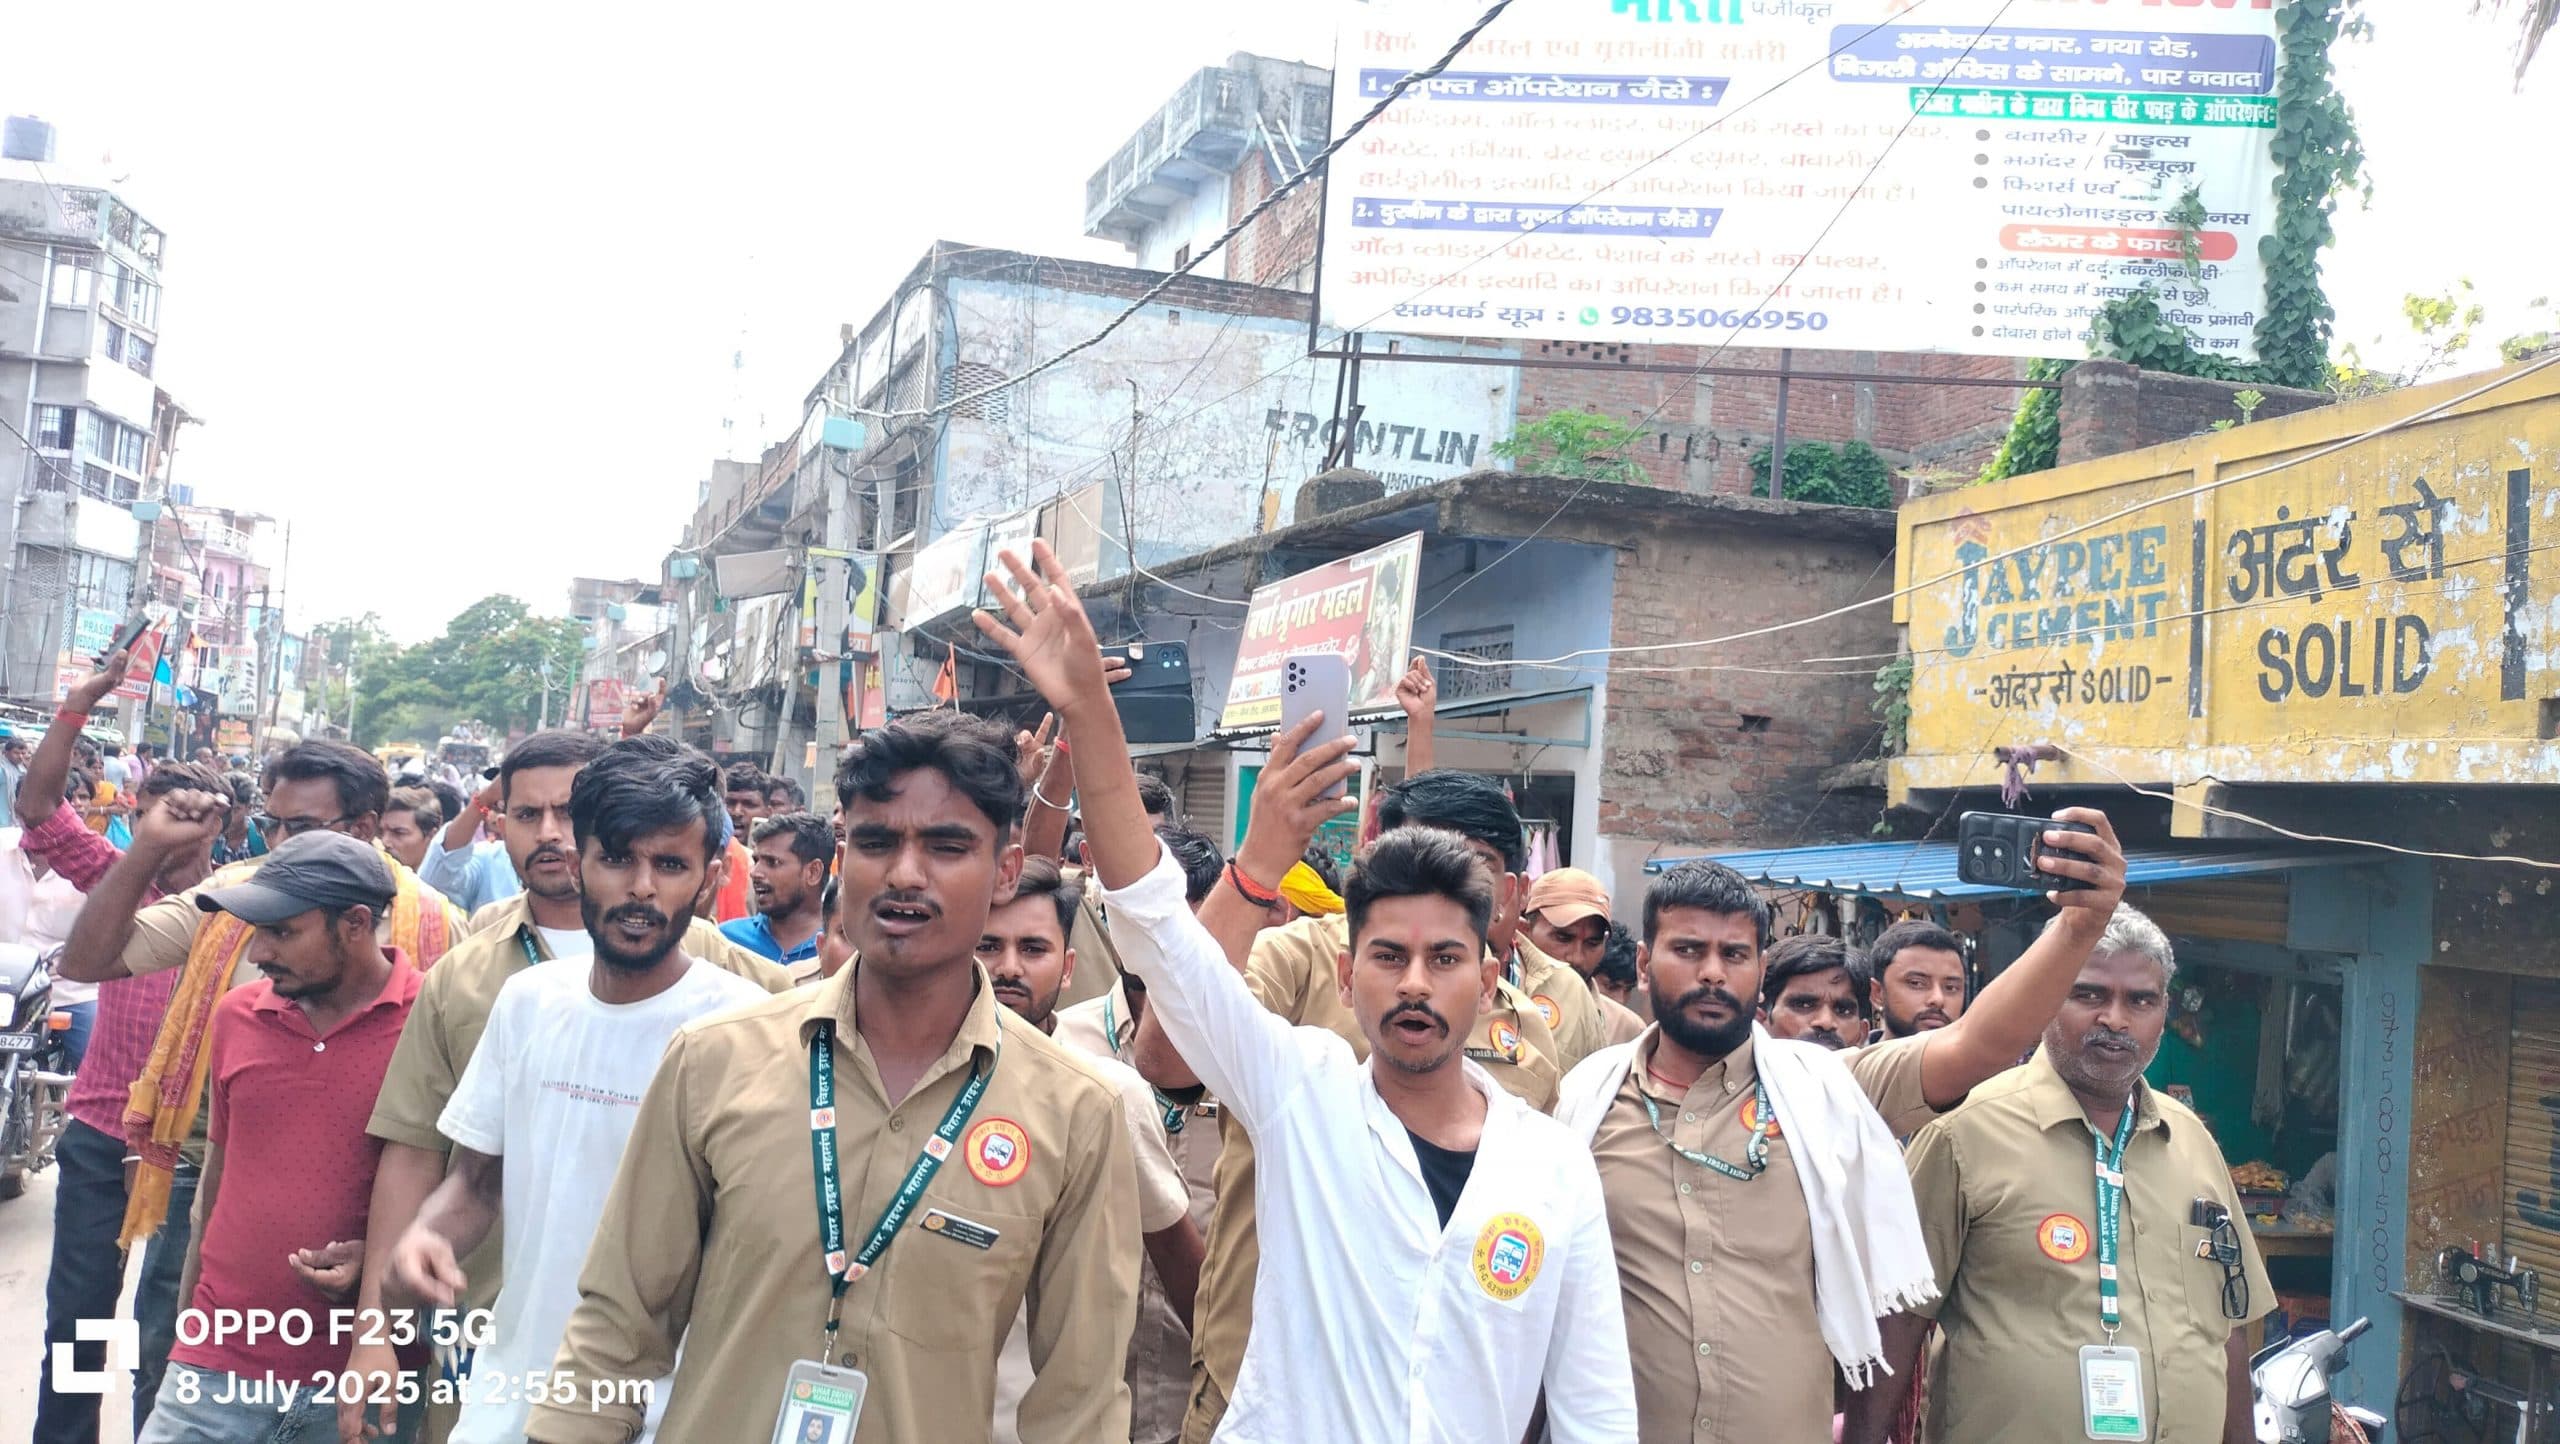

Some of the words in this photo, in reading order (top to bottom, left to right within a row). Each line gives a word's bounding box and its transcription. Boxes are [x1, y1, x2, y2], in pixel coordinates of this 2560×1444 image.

[2090, 38, 2144, 56] गया
[2149, 35, 2198, 59] रोड,
[2015, 59, 2045, 81] के
[2141, 69, 2184, 85] पार
[2188, 71, 2263, 88] नवादा
[1484, 76, 1621, 98] ऑपरेशन
[1628, 78, 1693, 99] जैसे
[2009, 92, 2029, 115] के
[2069, 94, 2105, 118] बिना
[2180, 97, 2198, 121] के
[2115, 132, 2192, 150] पाइल्स
[2083, 179, 2121, 195] एवं
[1447, 203, 1468, 221] के
[1657, 207, 1698, 228] जैसे
[2016, 229, 2086, 251] लेजर
[2091, 232, 2120, 250] के
[1670, 247, 1695, 266] के
[1705, 249, 1761, 267] रास्ते
[1772, 253, 1808, 268] का
[1997, 256, 2062, 272] ऑपरेशन
[2069, 258, 2084, 273] में
[1568, 275, 1601, 294] का
[1613, 276, 1719, 298] ऑपरेशन
[1729, 279, 1793, 299] किया
[1801, 285, 1862, 303] जाता
[1993, 282, 2023, 294] कम
[2030, 283, 2068, 296] समय
[2073, 281, 2090, 297] में
[2164, 286, 2179, 302] से
[1392, 300, 1489, 320] सम्पर्क
[1498, 304, 1544, 328] सूत्र
[1610, 305, 1829, 332] 9835066950
[2208, 311, 2254, 328] प्रभावी
[2042, 328, 2072, 342] होने
[2209, 337, 2240, 350] कम
[2226, 504, 2362, 605] अंदर
[2378, 475, 2457, 583] से
[1943, 525, 2167, 659] JAYPEE
[1986, 591, 2168, 651] CEMENT
[2257, 614, 2432, 704] SOLID
[2048, 659, 2077, 704] से
